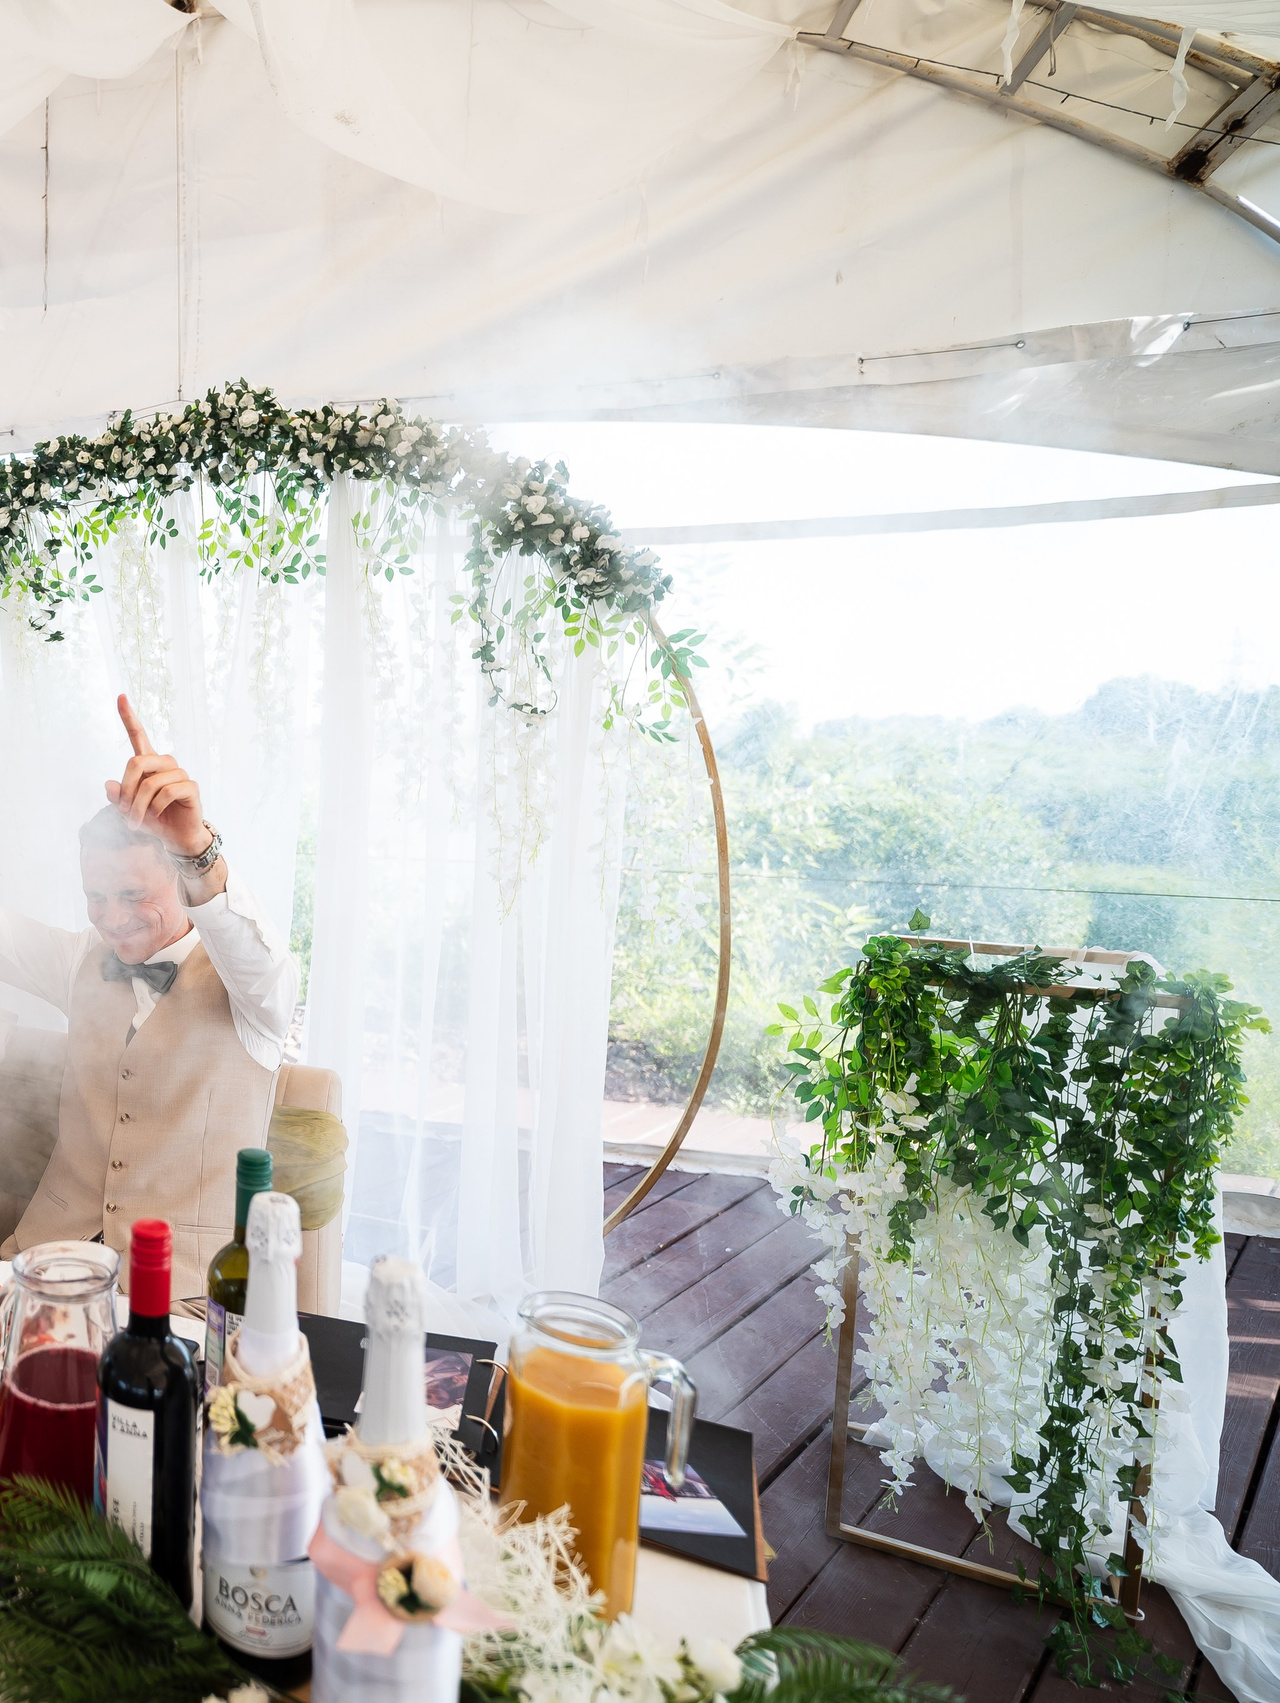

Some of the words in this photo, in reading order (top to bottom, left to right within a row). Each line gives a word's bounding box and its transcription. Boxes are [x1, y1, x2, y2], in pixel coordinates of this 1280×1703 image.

[111, 1413, 138, 1429] VILLA
[215, 1595, 243, 1619] ANNA
[247, 1612, 302, 1626] FEDERICA
[219, 1576, 298, 1614] BOSCA
